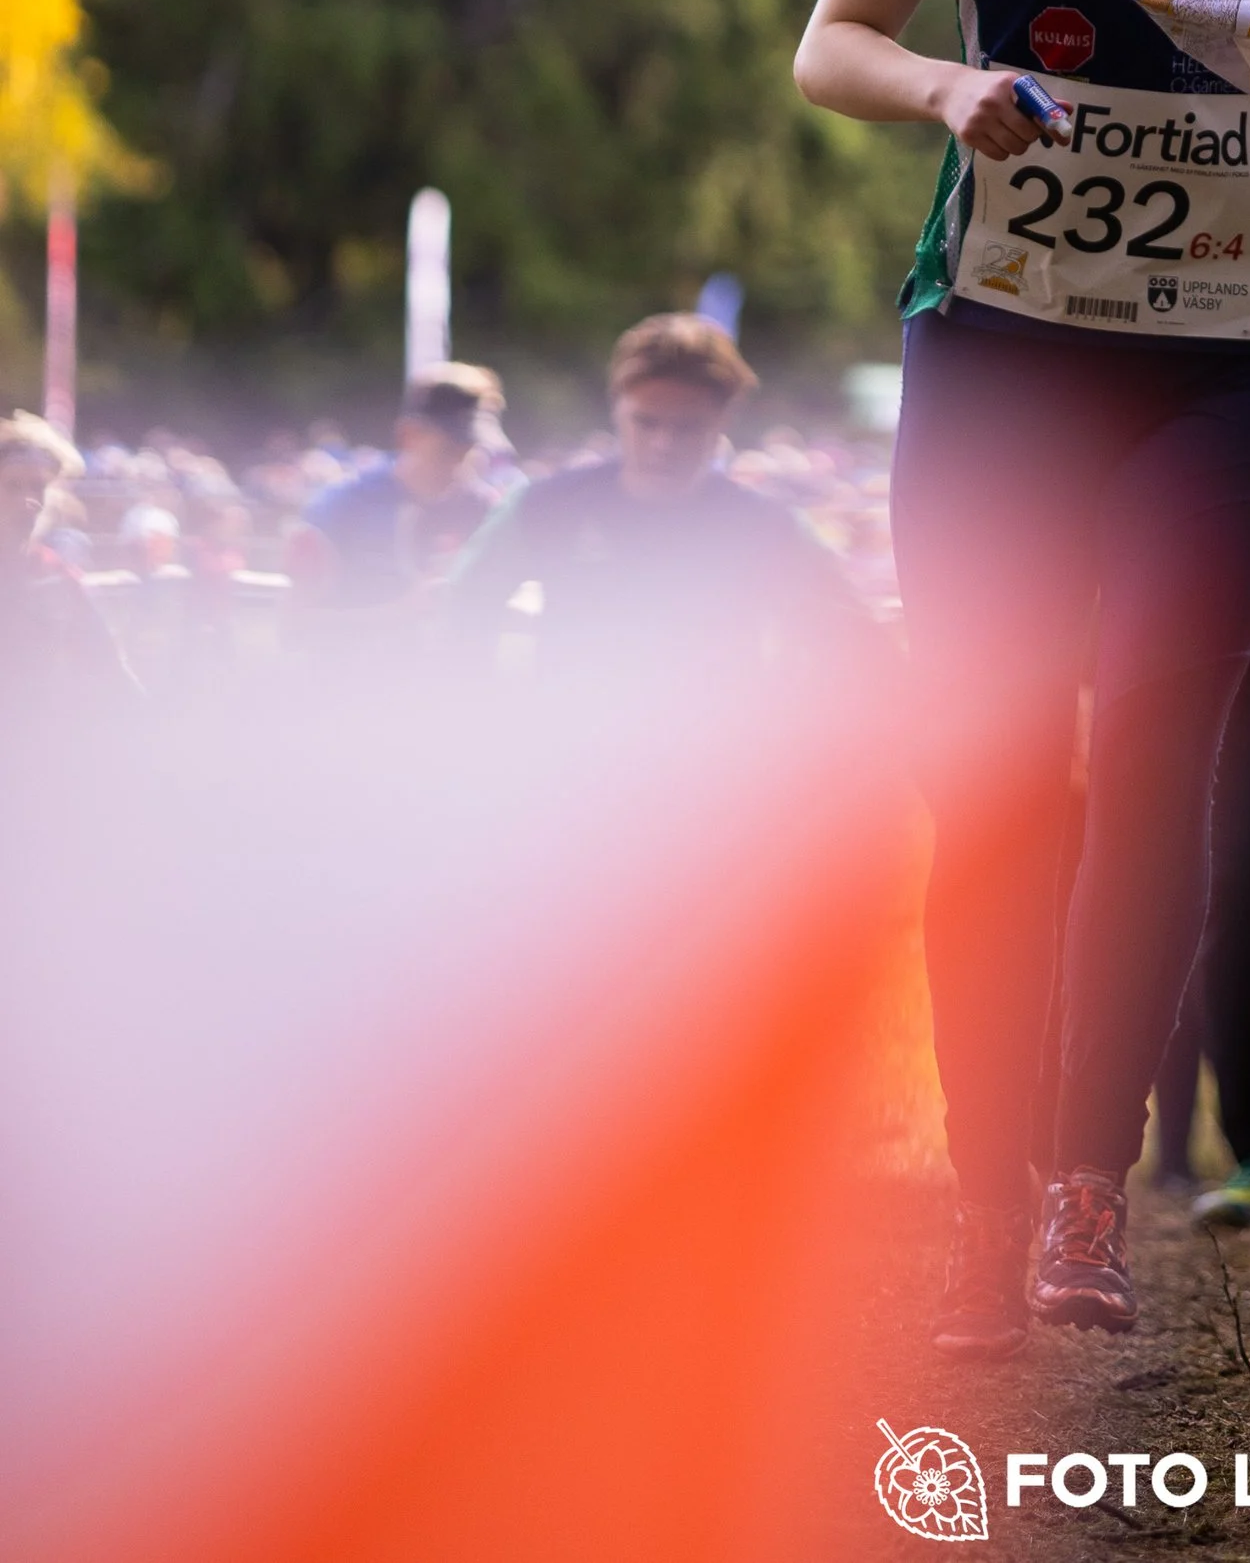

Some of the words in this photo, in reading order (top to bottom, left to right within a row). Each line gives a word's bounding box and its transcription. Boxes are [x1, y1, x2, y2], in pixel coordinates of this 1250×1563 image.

[1034, 30, 1091, 48] KULMIS
[1071, 103, 1249, 166] Fortiad
[1008, 165, 1190, 260] 232
[1190, 233, 1244, 260] 6:4
[1183, 280, 1248, 296] UPPLANDS
[1183, 294, 1222, 310] VÄSBY
